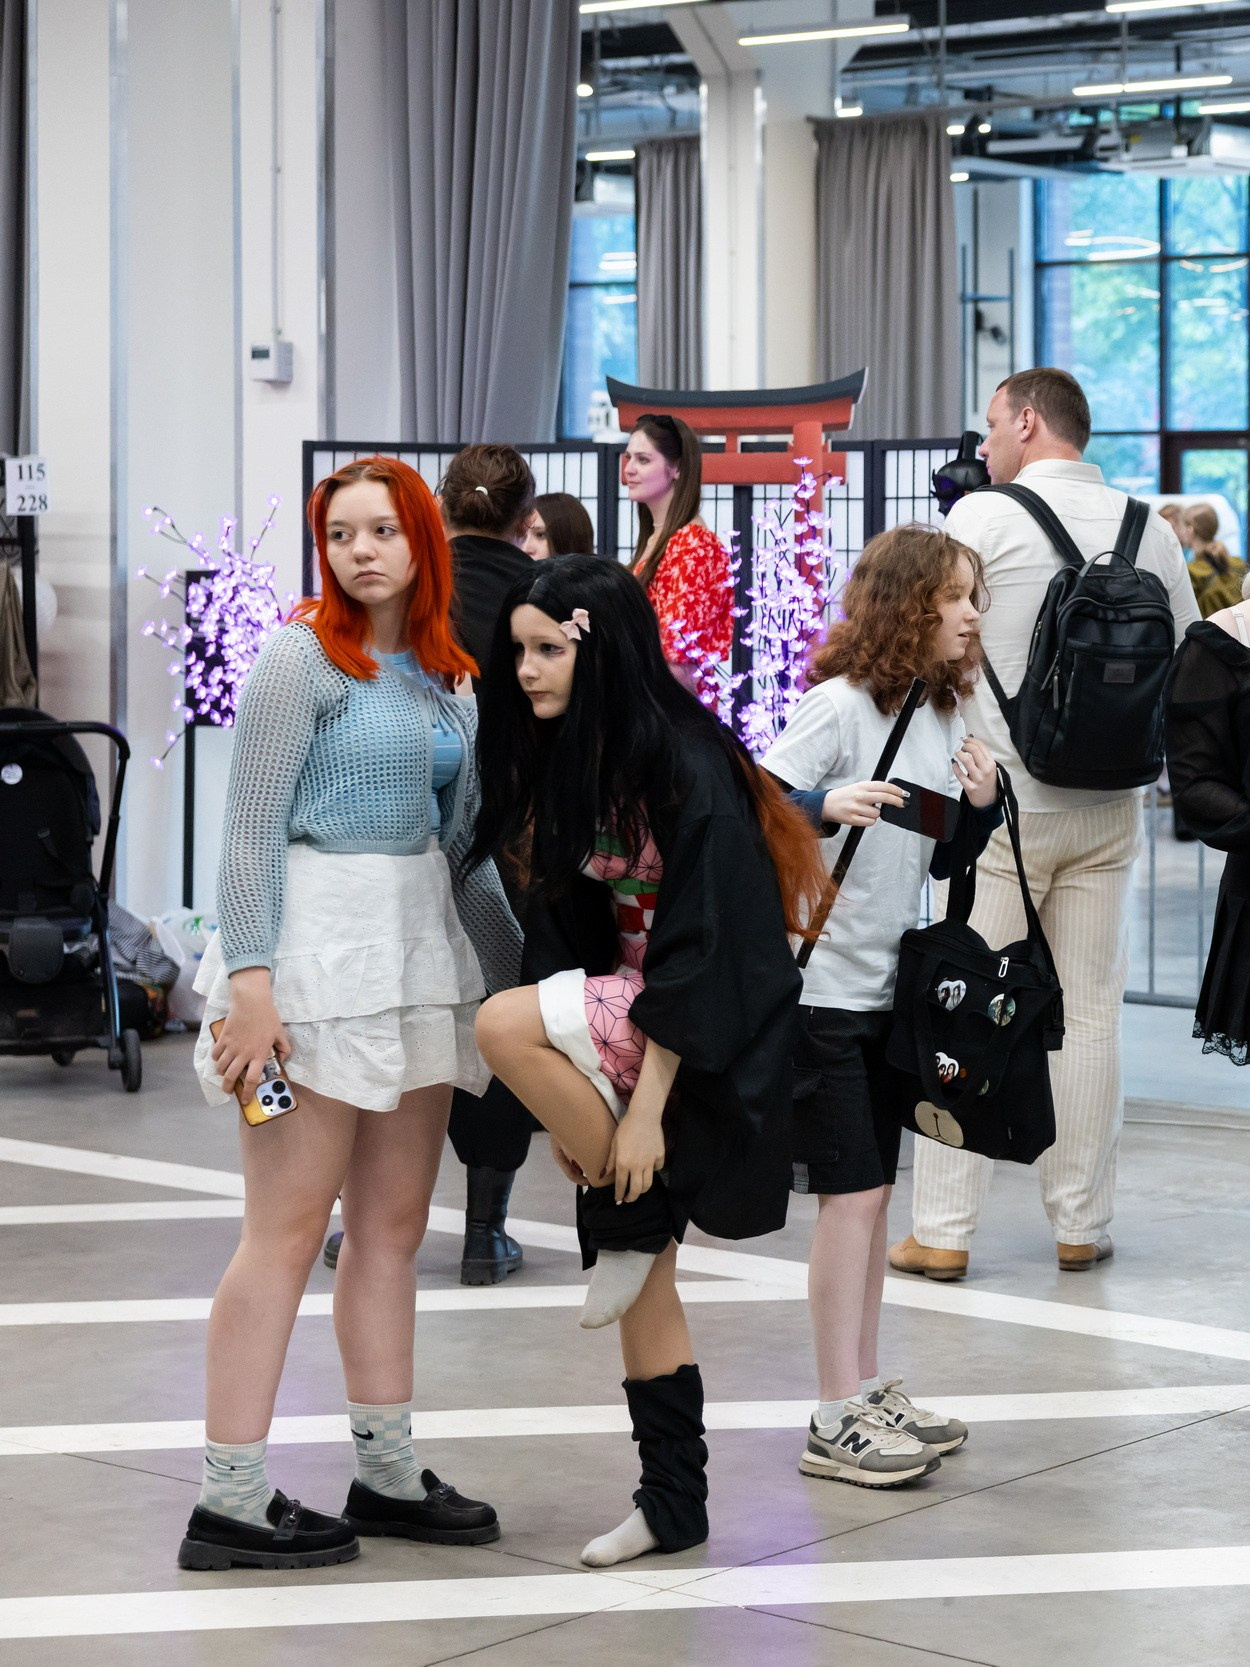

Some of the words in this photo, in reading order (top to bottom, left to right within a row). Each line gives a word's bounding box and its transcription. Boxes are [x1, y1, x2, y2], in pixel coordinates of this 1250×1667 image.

[18, 463, 45, 481] 115
[17, 494, 47, 511] 228
[840, 1431, 873, 1457] N
